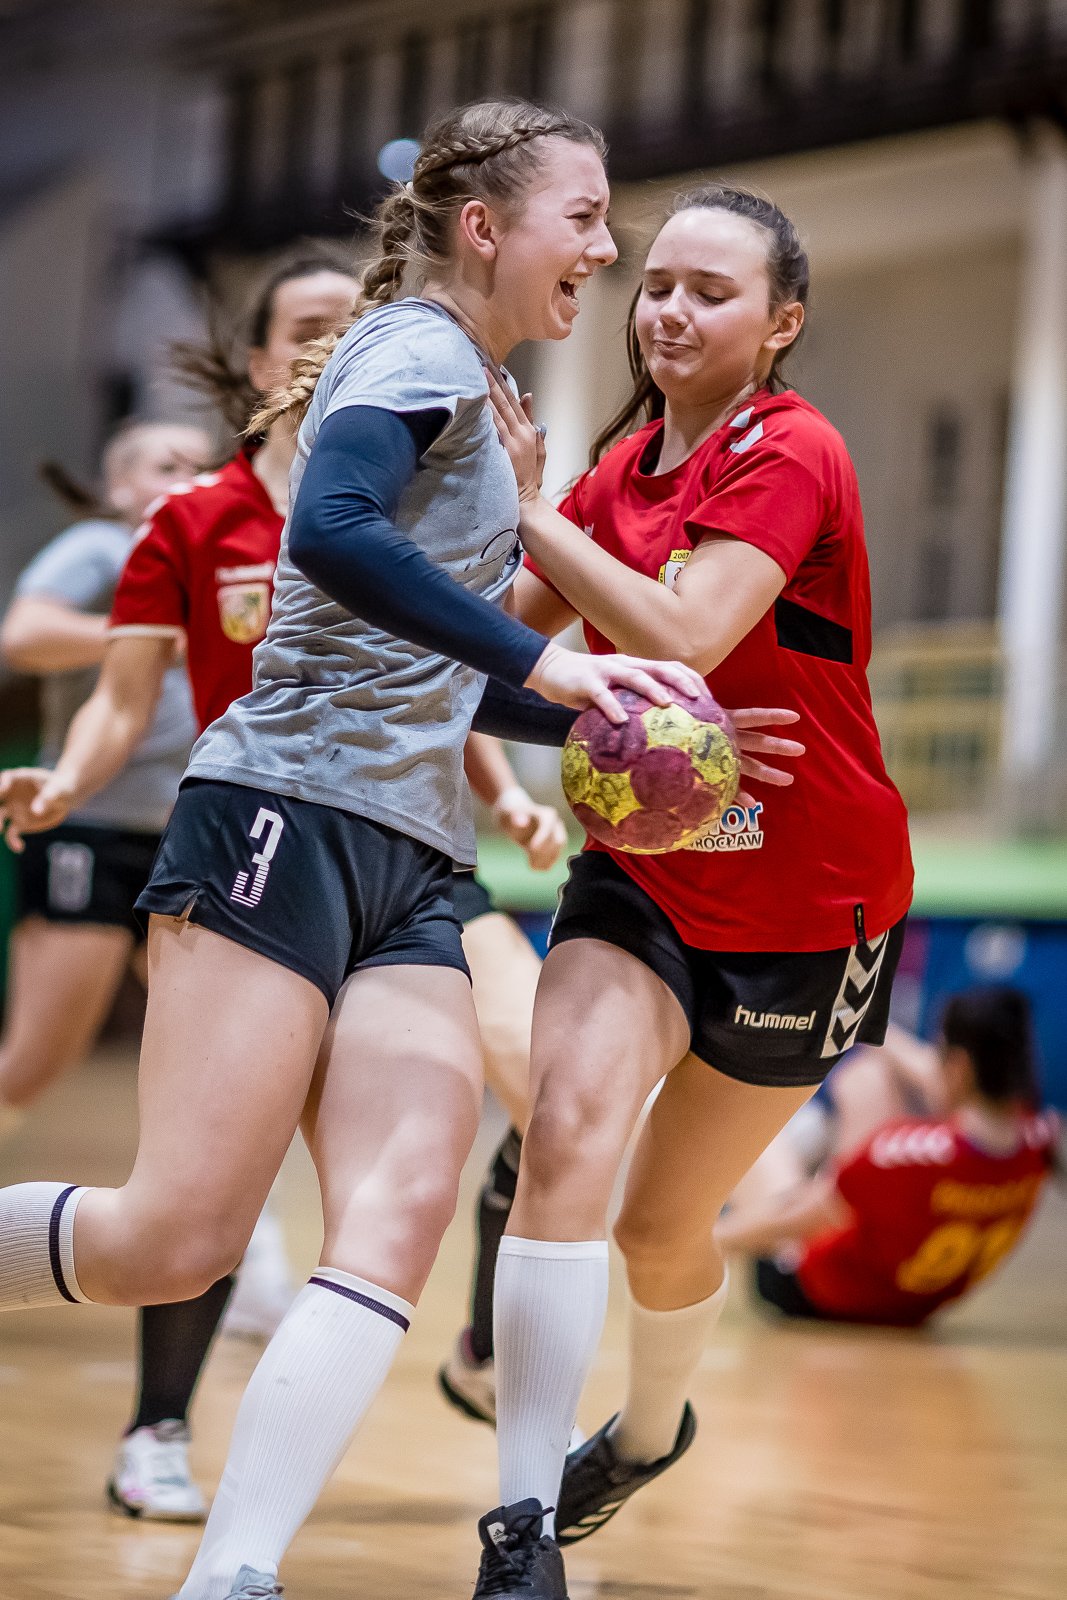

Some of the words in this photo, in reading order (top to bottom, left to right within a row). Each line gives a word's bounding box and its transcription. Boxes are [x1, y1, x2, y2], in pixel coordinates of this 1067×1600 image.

[709, 804, 762, 834] or
[690, 833, 762, 849] ROCŁAW
[230, 807, 284, 907] 3
[734, 1004, 817, 1031] hummel
